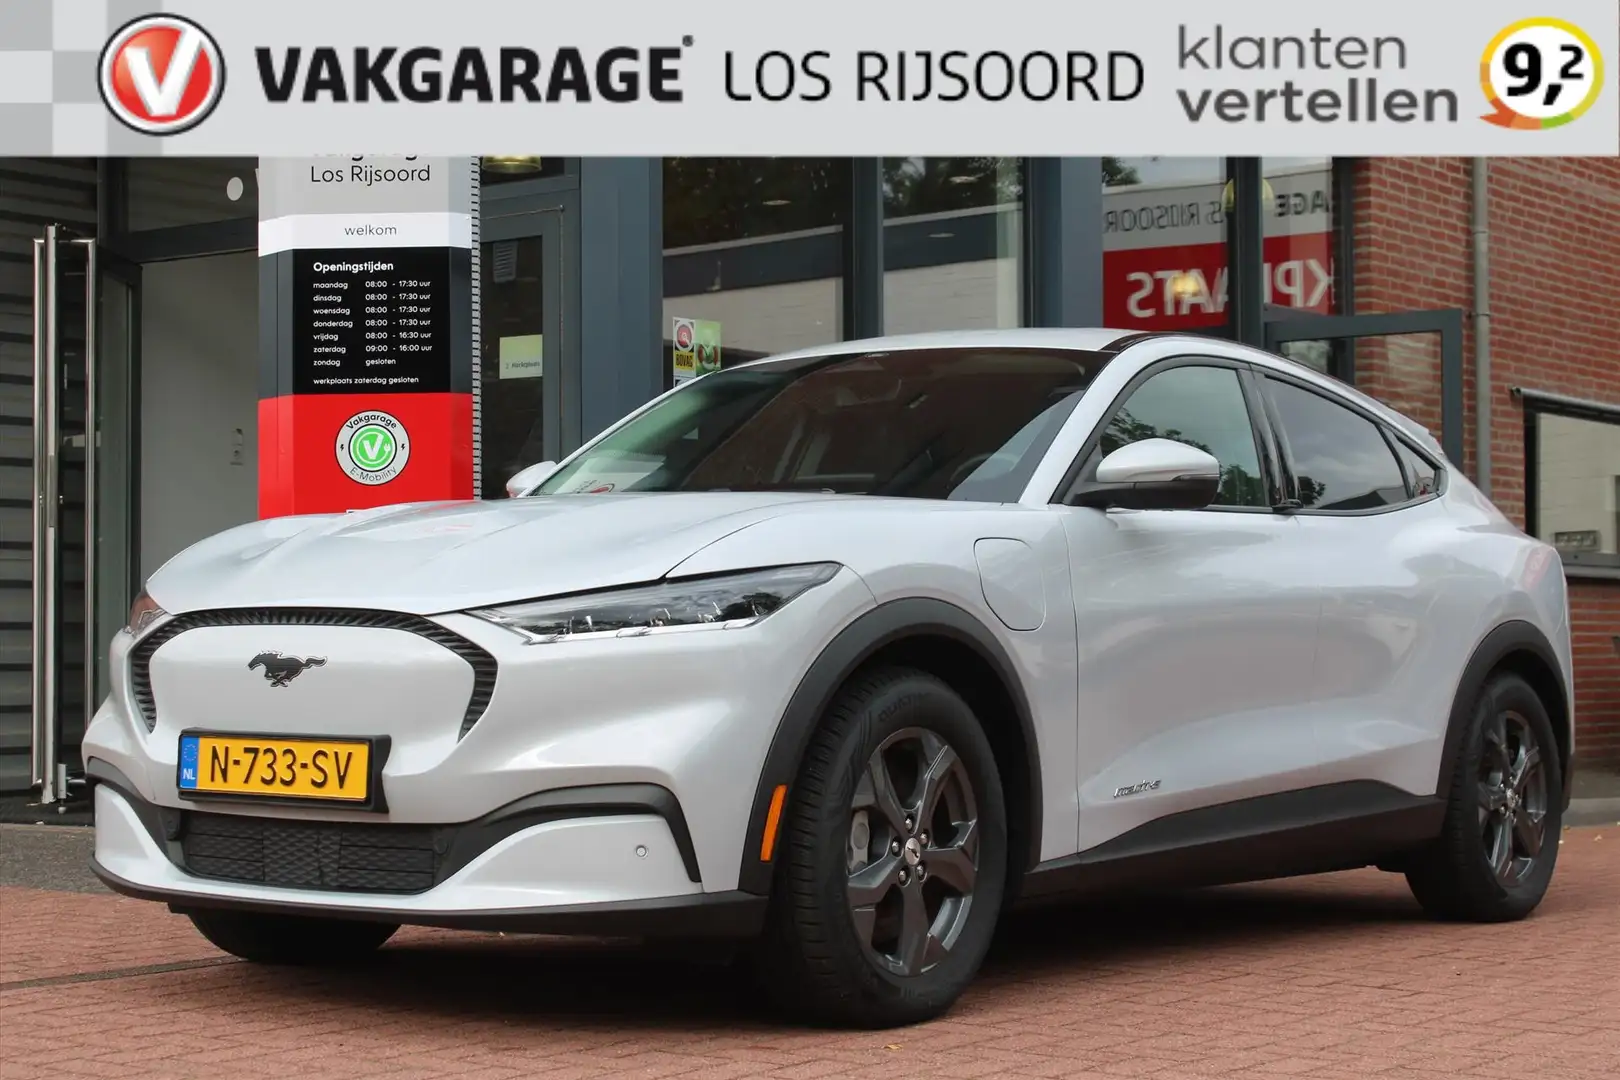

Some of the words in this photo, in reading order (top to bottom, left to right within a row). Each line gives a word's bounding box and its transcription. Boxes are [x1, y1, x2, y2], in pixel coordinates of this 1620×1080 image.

[311, 165, 344, 183] Los
[351, 164, 430, 187] Rijsoord
[344, 224, 397, 236] welkom
[313, 260, 394, 274] Openingstijden
[312, 281, 349, 290] maandag
[364, 280, 388, 288] 08:00
[312, 294, 342, 303] dinsdag
[364, 293, 388, 301] 08:00
[398, 292, 418, 300] 17:30
[312, 307, 351, 316] woensdag
[365, 306, 388, 314] 08:00
[399, 305, 418, 313] 17:30
[312, 320, 354, 329] donderdag
[365, 319, 388, 327] 08:00
[399, 318, 419, 326] 17:30
[313, 333, 339, 342] vrijdag
[365, 331, 388, 340] 08:00
[399, 331, 419, 339] 16:30
[313, 345, 347, 354] zaterdag
[365, 344, 389, 352] 09:00
[399, 344, 420, 352] 16:00
[313, 359, 341, 368] zondag
[365, 358, 397, 367] gesloten
[313, 377, 353, 386] werkplaats
[354, 376, 387, 385] zaterdag
[388, 376, 419, 385] gesloten
[346, 414, 397, 429] Vakgarage
[349, 466, 397, 482] E-Mobility
[182, 768, 196, 781] NL
[210, 745, 353, 790] N-733-SV
